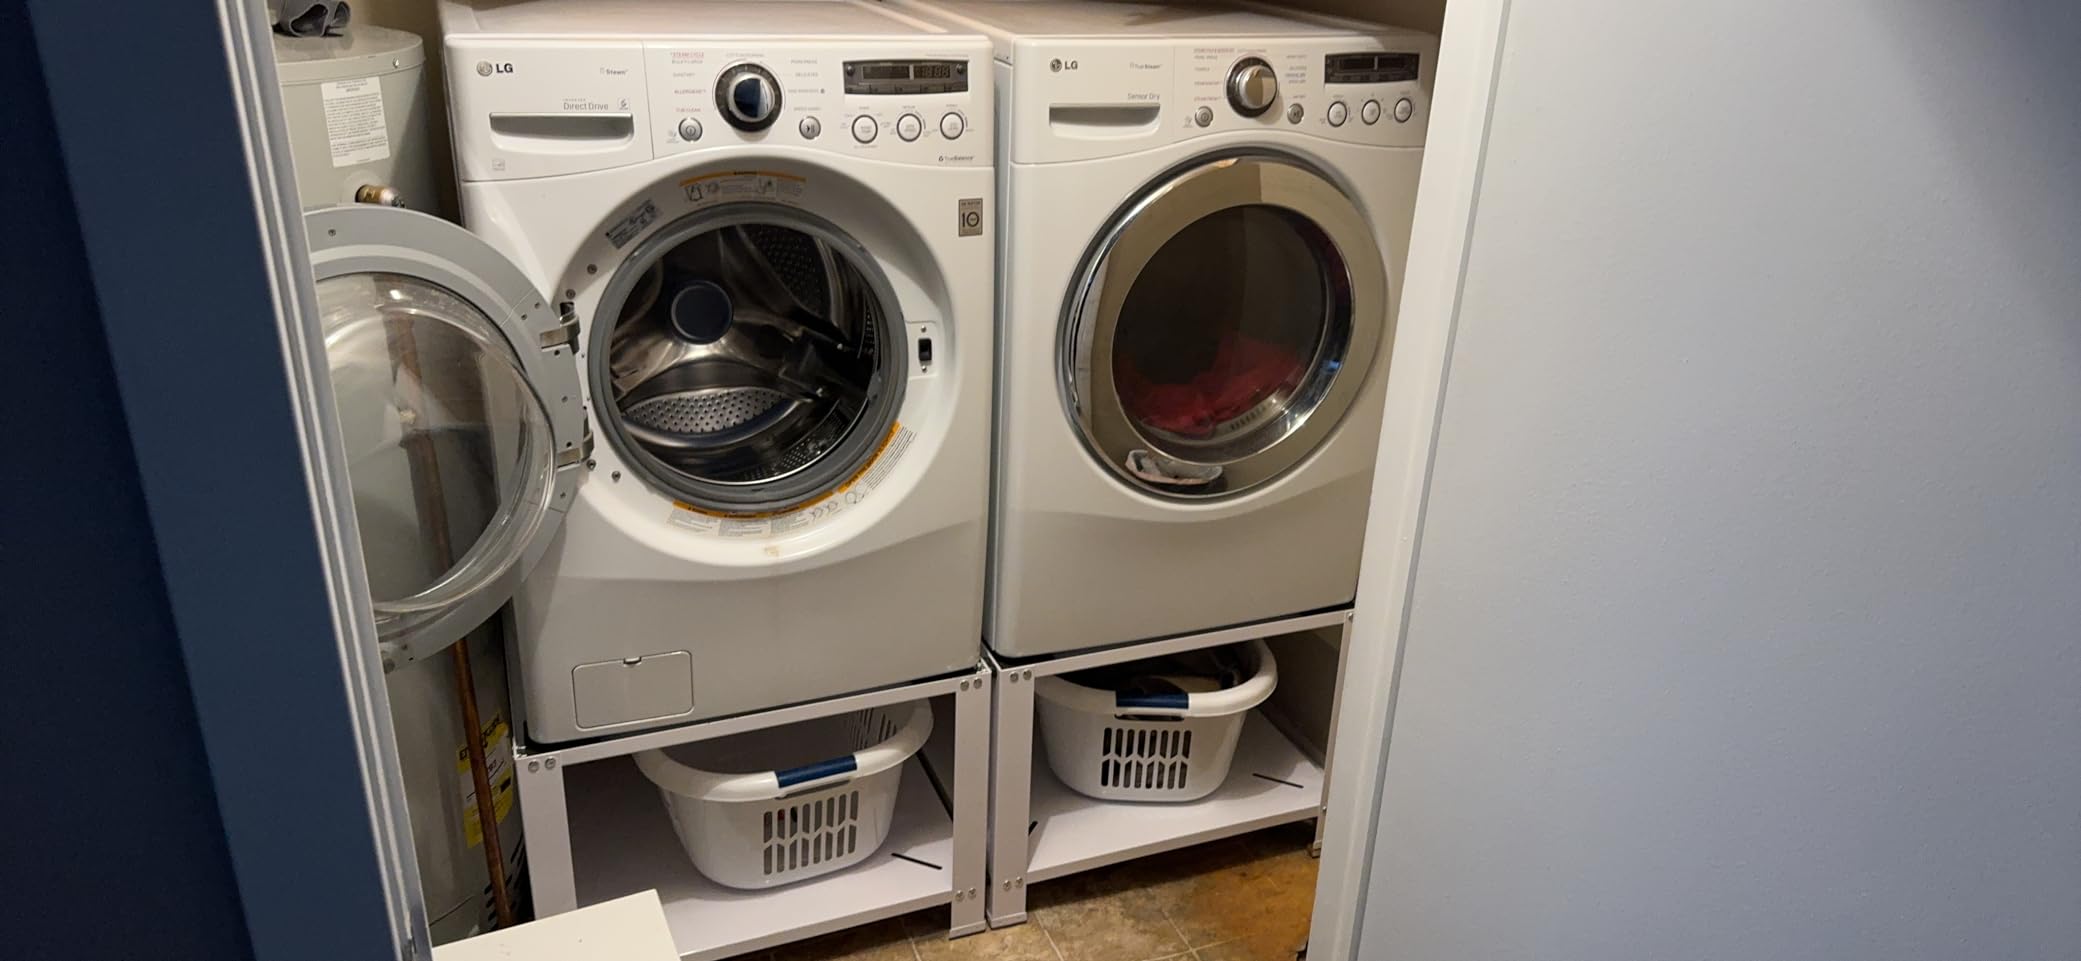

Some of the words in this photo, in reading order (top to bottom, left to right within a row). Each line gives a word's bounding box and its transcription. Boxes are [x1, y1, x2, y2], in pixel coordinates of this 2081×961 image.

[496, 63, 514, 73] LG
[1064, 60, 1079, 71] LG
[563, 102, 587, 110] Direct
[588, 102, 609, 110] Drive
[961, 211, 980, 228] 10
